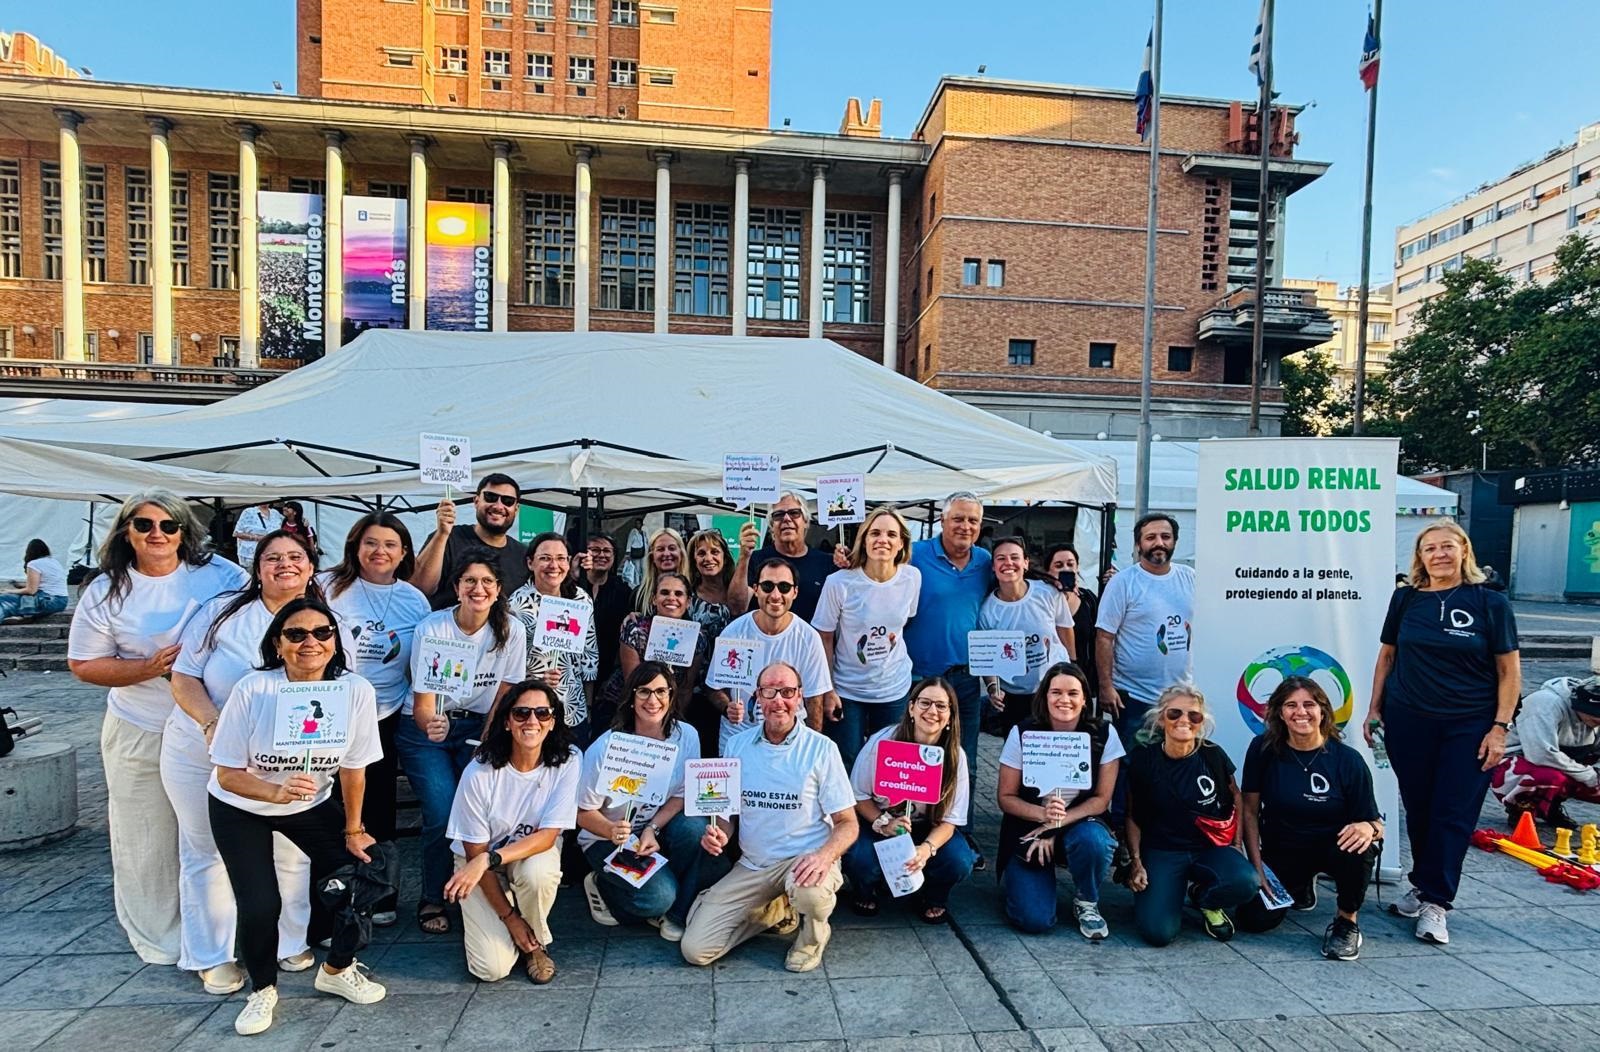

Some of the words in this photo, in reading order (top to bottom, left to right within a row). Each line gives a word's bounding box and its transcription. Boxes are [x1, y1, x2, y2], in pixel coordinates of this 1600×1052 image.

[303, 213, 322, 341] Montevideo
[384, 259, 406, 304] más
[472, 246, 489, 329] nuestro
[1224, 468, 1300, 491] SALUD
[1308, 467, 1381, 490] RENAL
[1226, 510, 1291, 533] PARA
[1299, 510, 1371, 533] TODOS
[1235, 567, 1289, 579] Cuidando
[1292, 569, 1300, 579] a
[1303, 567, 1314, 579] la
[1318, 568, 1353, 580] gente,
[1226, 588, 1298, 600] protegiendo
[1301, 588, 1312, 600] al
[1316, 588, 1362, 601] planeta.
[366, 620, 385, 632] 20
[1167, 614, 1182, 626] 20
[870, 625, 887, 637] 20
[425, 638, 450, 647] GOLDEN
[451, 641, 465, 649] RULE
[1025, 634, 1040, 645] 20
[612, 734, 646, 746] Obesidad:
[647, 742, 677, 753] principal
[254, 753, 299, 764] ¿COMO
[609, 744, 629, 753] factor
[640, 750, 660, 761] riesgo
[662, 754, 671, 762] de
[614, 756, 655, 769] enfermedad
[884, 756, 926, 771] Controla
[604, 765, 623, 773] renal
[622, 767, 647, 778] crónica
[899, 771, 909, 780] tu
[879, 780, 928, 793] creatinina
[769, 792, 798, 801] ESTÁN
[514, 823, 533, 836] 20
